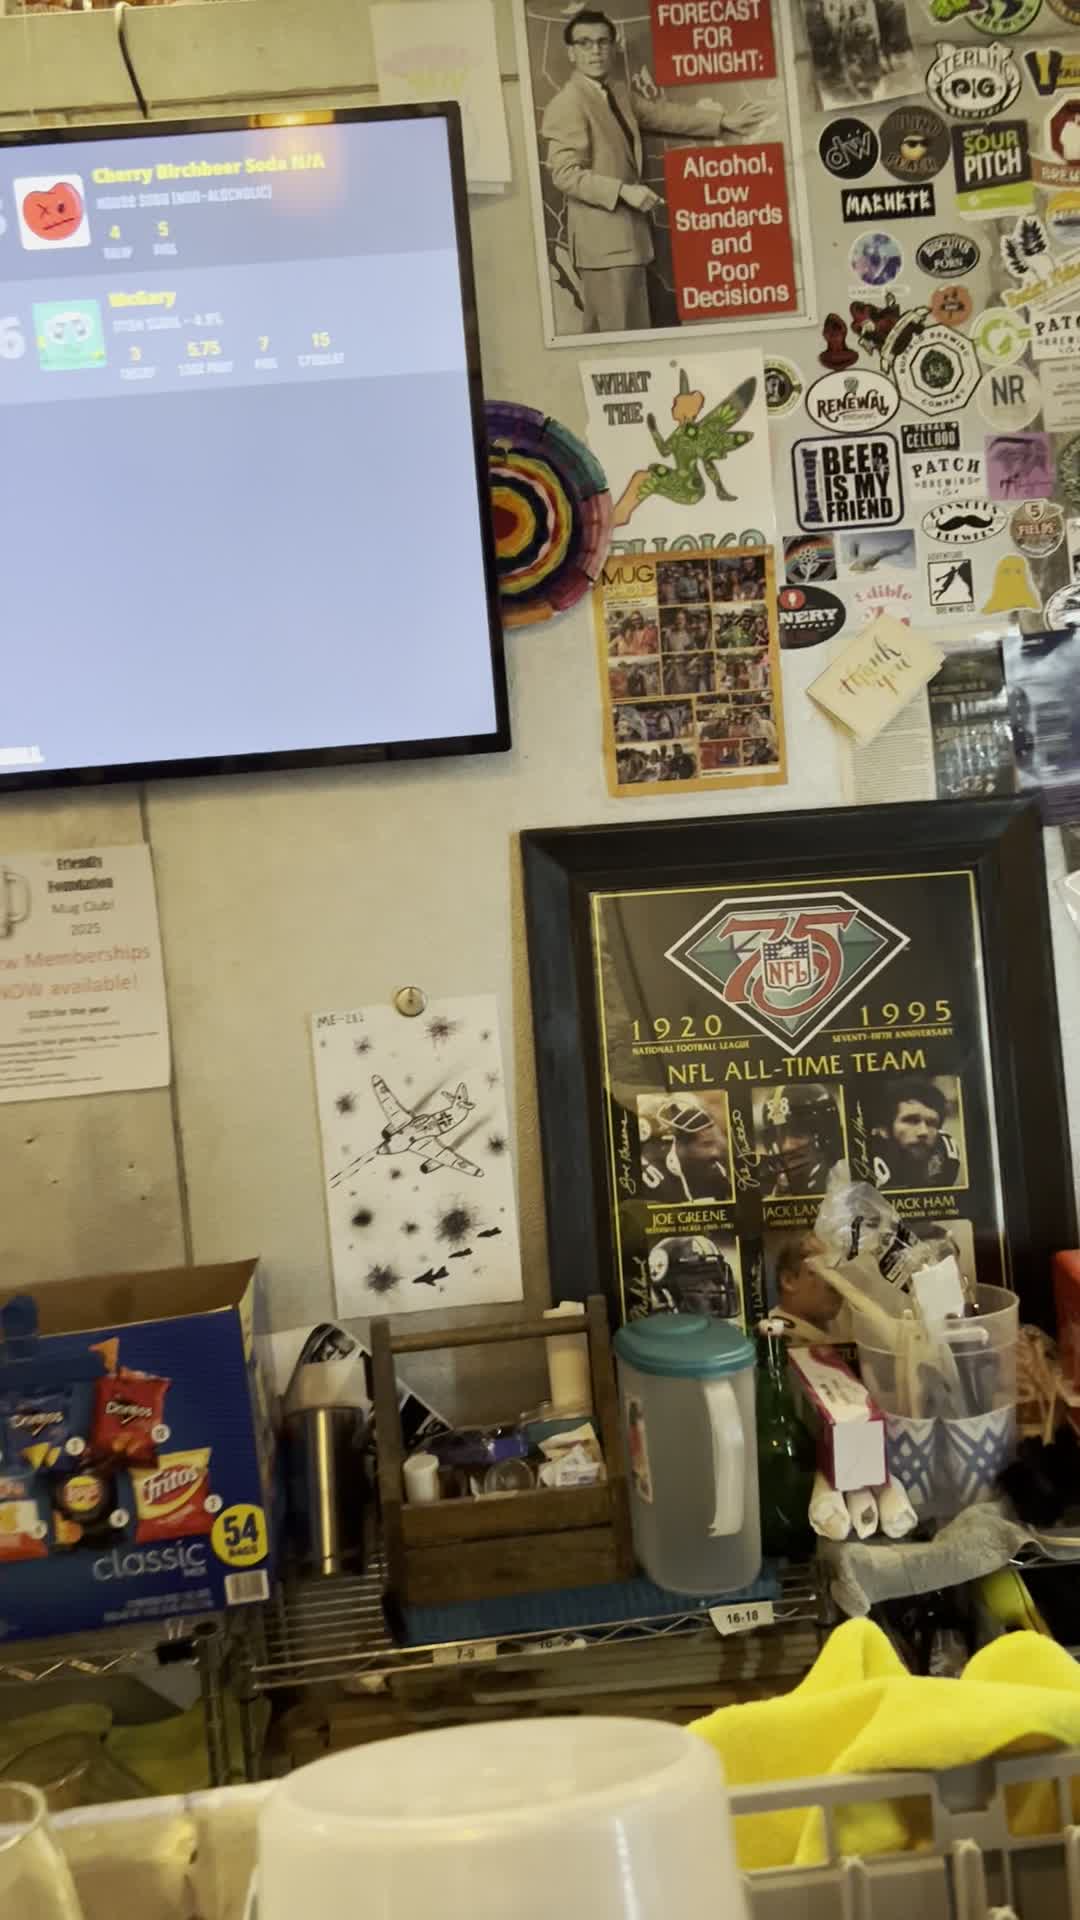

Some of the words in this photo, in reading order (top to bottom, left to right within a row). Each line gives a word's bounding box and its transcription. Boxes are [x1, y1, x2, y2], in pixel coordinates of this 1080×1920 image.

[658, 0, 760, 26] FORECAST
[693, 26, 732, 49] FOR
[672, 50, 764, 77] TONIGHT:
[964, 130, 1018, 155] SOUR
[683, 152, 773, 179] Alcohol,
[964, 146, 1022, 183] PITCH
[704, 183, 750, 205] Low
[157, 220, 169, 237] 5
[676, 203, 783, 231] Standards
[711, 232, 752, 255] and
[707, 262, 760, 283] Poor
[683, 284, 789, 310] Decisions
[311, 331, 331, 348] 15
[592, 371, 651, 396] WHAT
[991, 375, 1025, 406] NR
[603, 402, 644, 425] THE
[817, 390, 889, 422] RENEWAL
[821, 442, 890, 476] BEER
[912, 457, 980, 478] PATCH
[824, 475, 849, 501] IS
[854, 472, 890, 499] MY
[826, 498, 893, 523] FRIEND
[1031, 505, 1040, 518] 5
[601, 564, 655, 586] MUG
[49, 972, 138, 996] available!
[768, 959, 809, 988] NFL
[860, 1000, 952, 1027] 1995
[631, 1014, 723, 1041] 1920
[668, 1064, 714, 1085] NFL
[724, 1055, 843, 1080] ALL-TIME
[852, 1050, 927, 1073] TEAM
[924, 1195, 956, 1209] HAM
[652, 1213, 674, 1227] JOE
[677, 1210, 727, 1223] GREENE
[223, 1513, 259, 1547] 54
[92, 1540, 207, 1581] classic
[727, 1610, 759, 1625] 16-18
